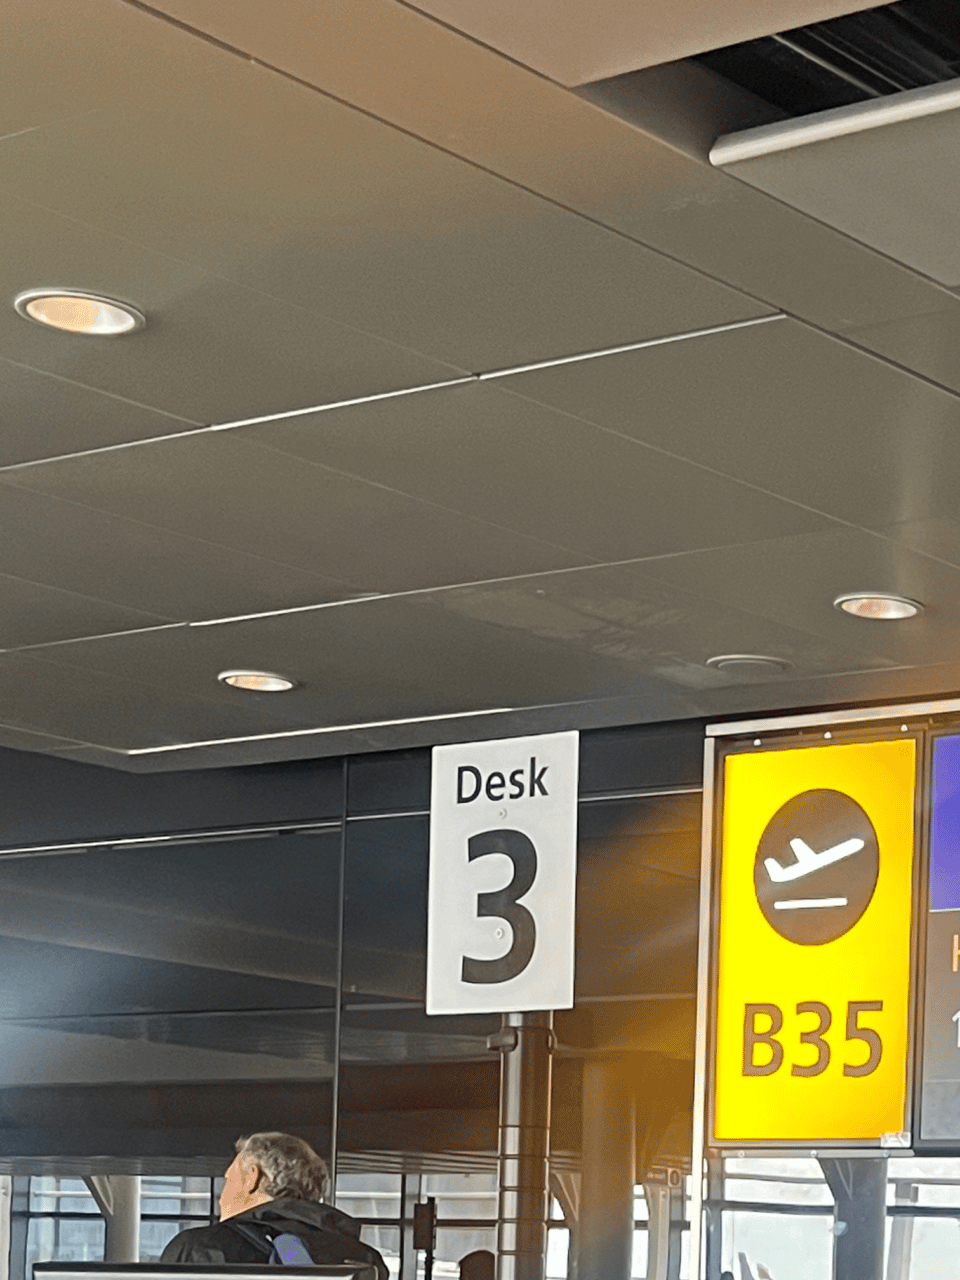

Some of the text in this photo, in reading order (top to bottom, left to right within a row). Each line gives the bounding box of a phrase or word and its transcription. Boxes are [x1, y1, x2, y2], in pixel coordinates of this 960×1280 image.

[456, 757, 550, 804] Desk
[460, 828, 538, 984] 3
[741, 1000, 884, 1078] B35
